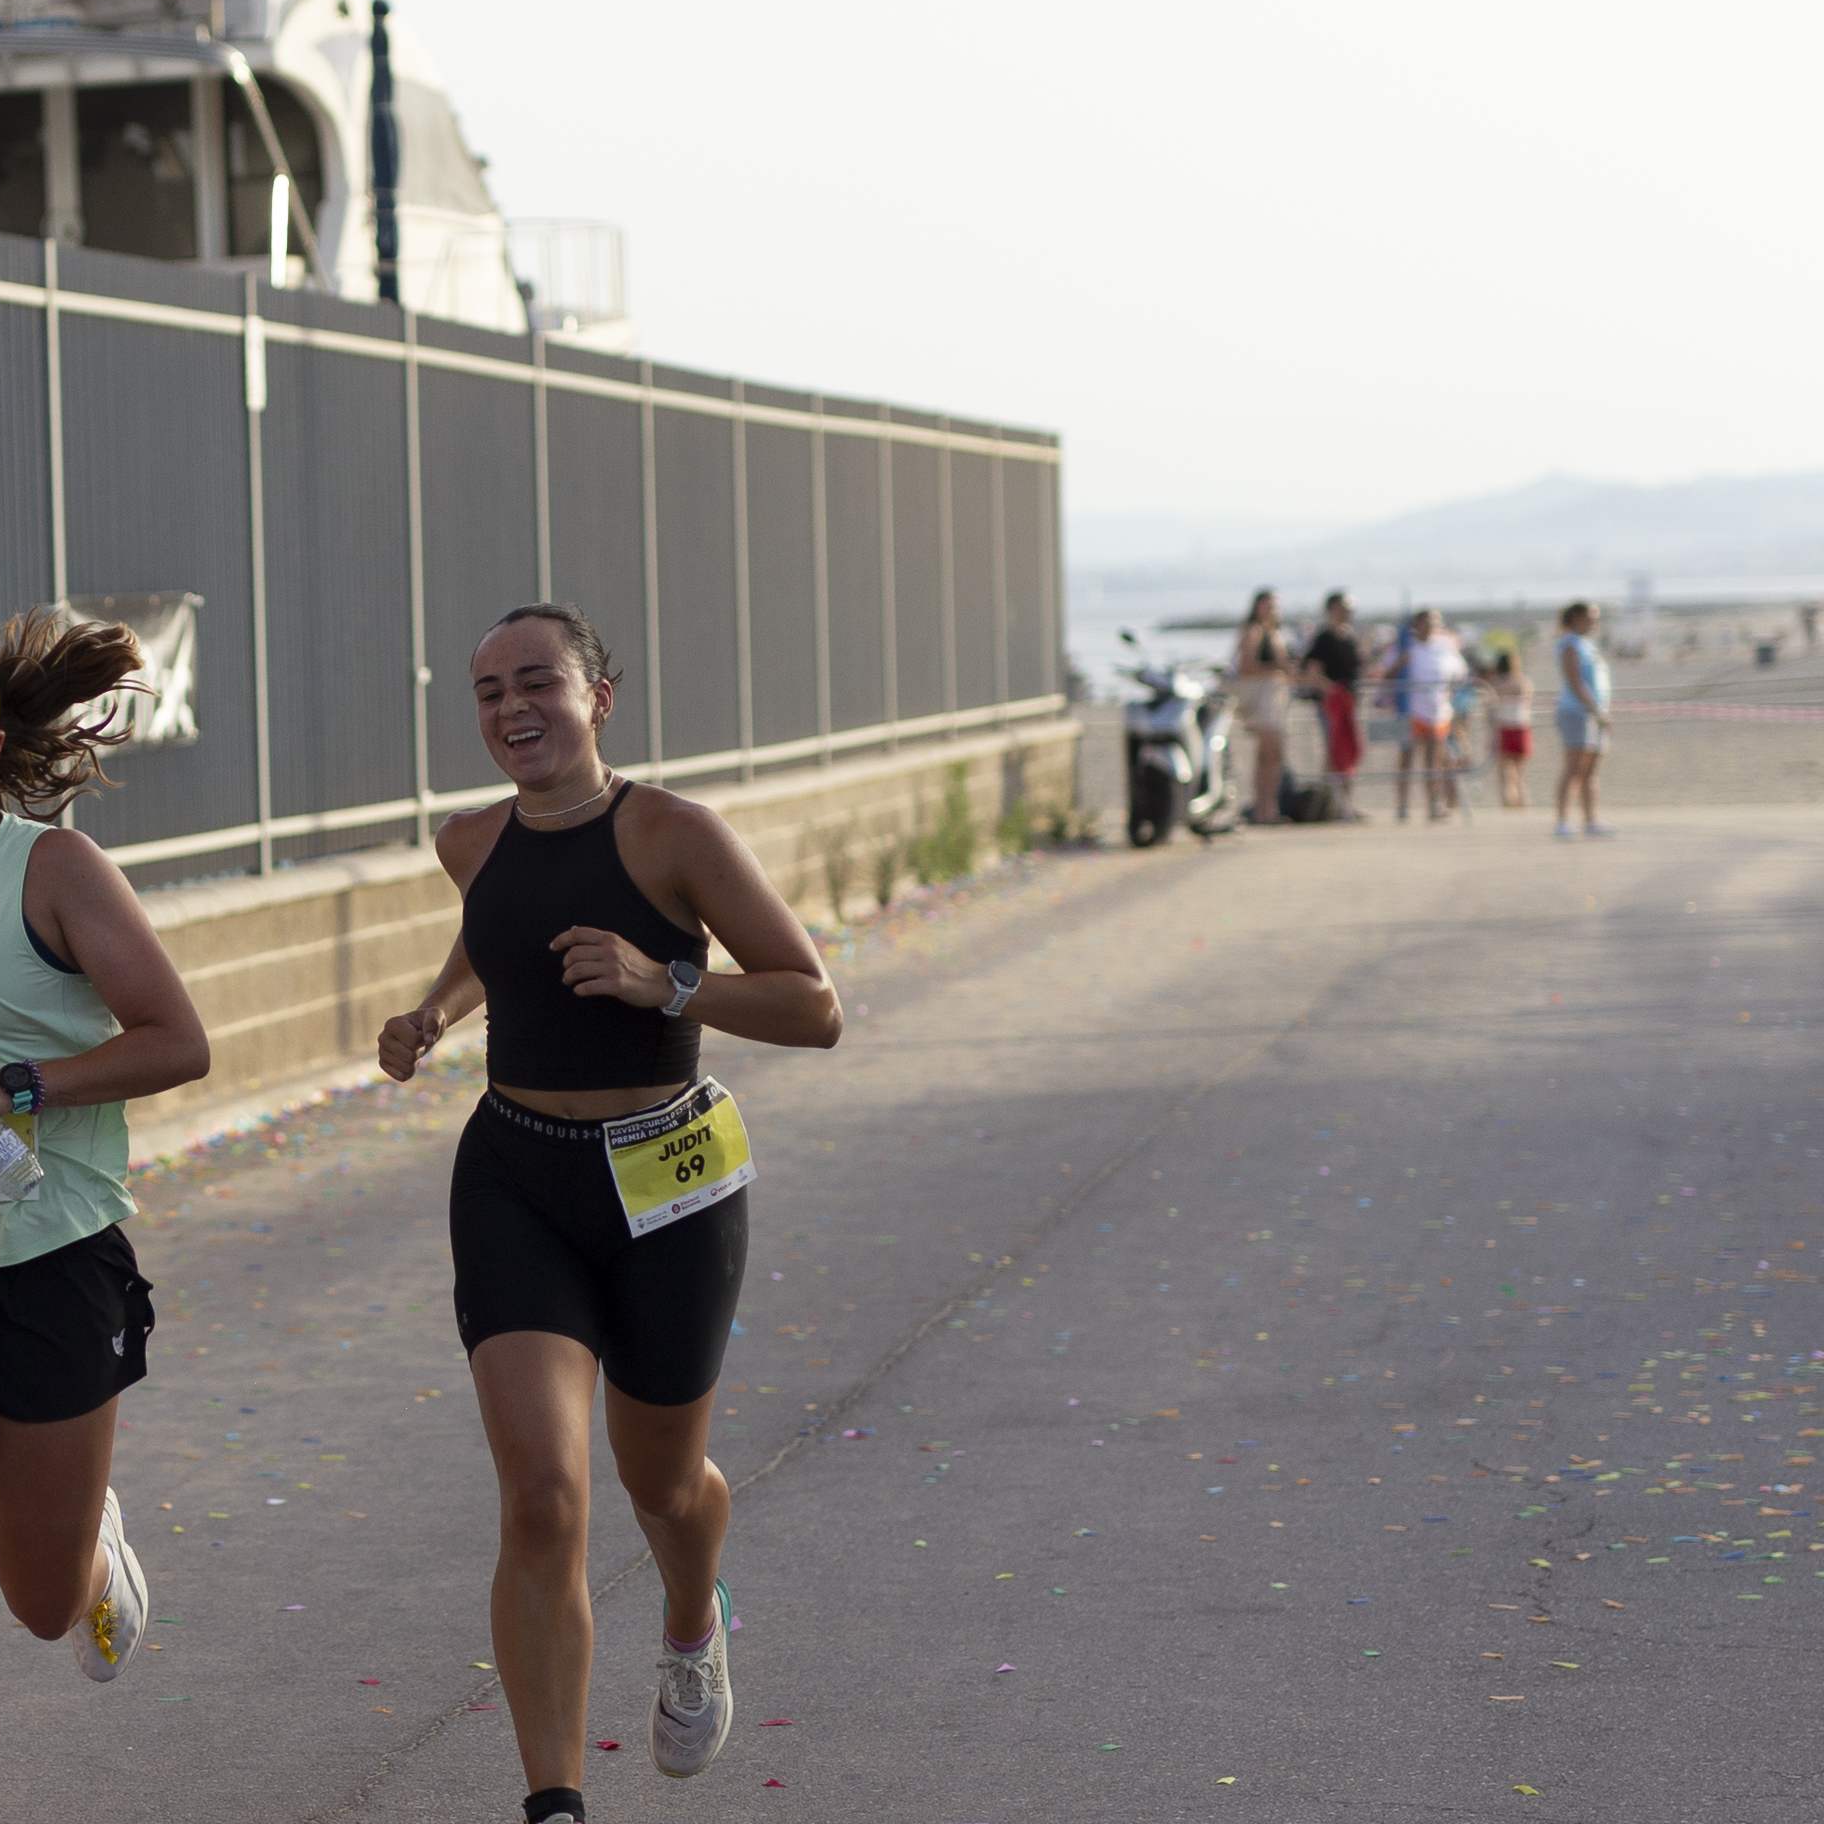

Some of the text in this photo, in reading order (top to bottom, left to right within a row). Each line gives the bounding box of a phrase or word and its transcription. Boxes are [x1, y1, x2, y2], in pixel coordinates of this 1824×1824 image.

[514, 1112, 578, 1140] ARMOUR
[658, 1123, 713, 1162] JUDIT
[675, 1153, 706, 1184] 69
